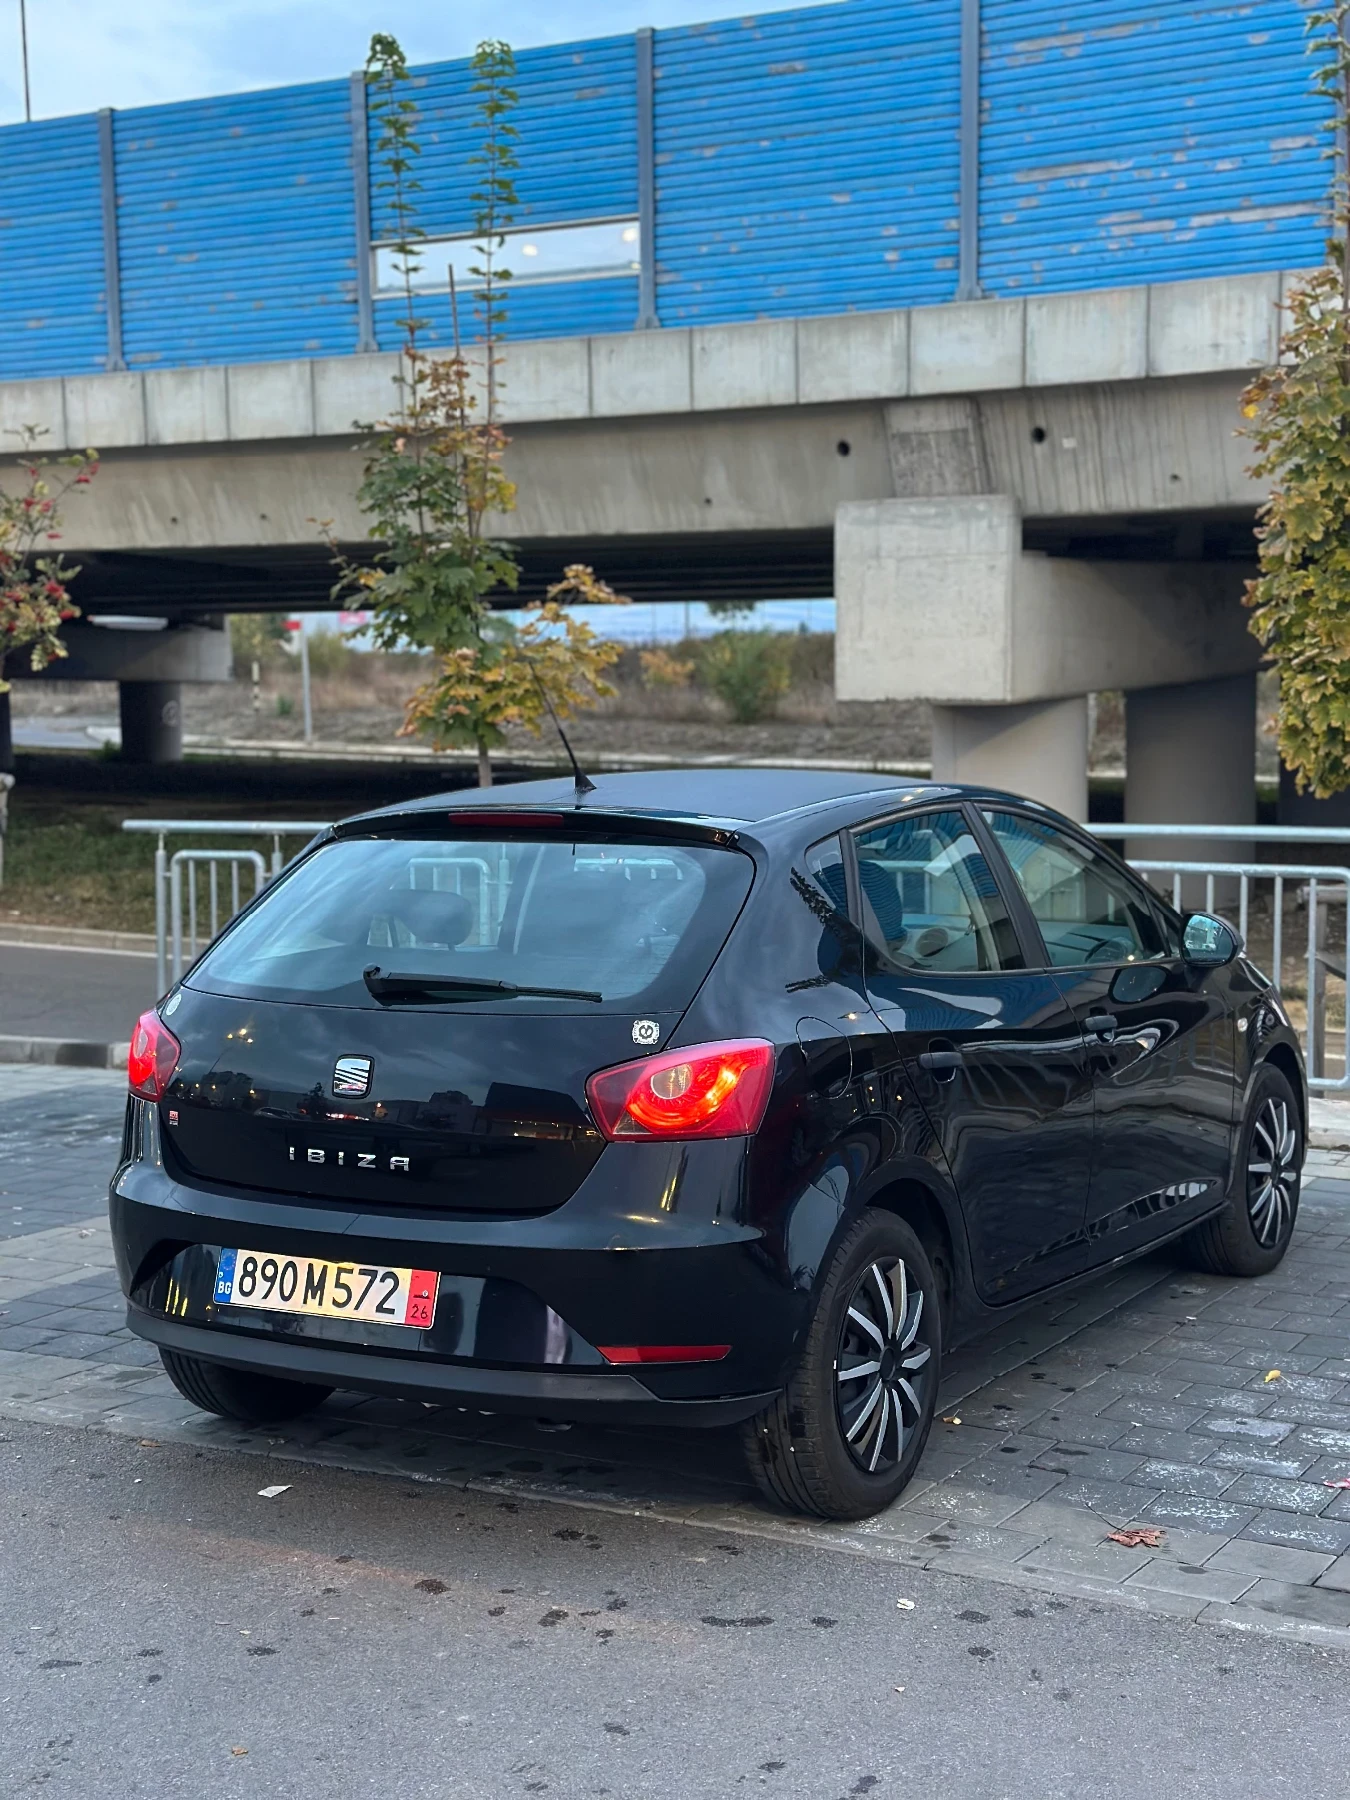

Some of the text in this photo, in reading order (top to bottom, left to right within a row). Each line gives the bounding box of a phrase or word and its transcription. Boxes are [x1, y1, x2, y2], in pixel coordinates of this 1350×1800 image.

[289, 1146, 410, 1172] IBIZA
[217, 1281, 232, 1295] BG
[410, 1303, 429, 1319] 26
